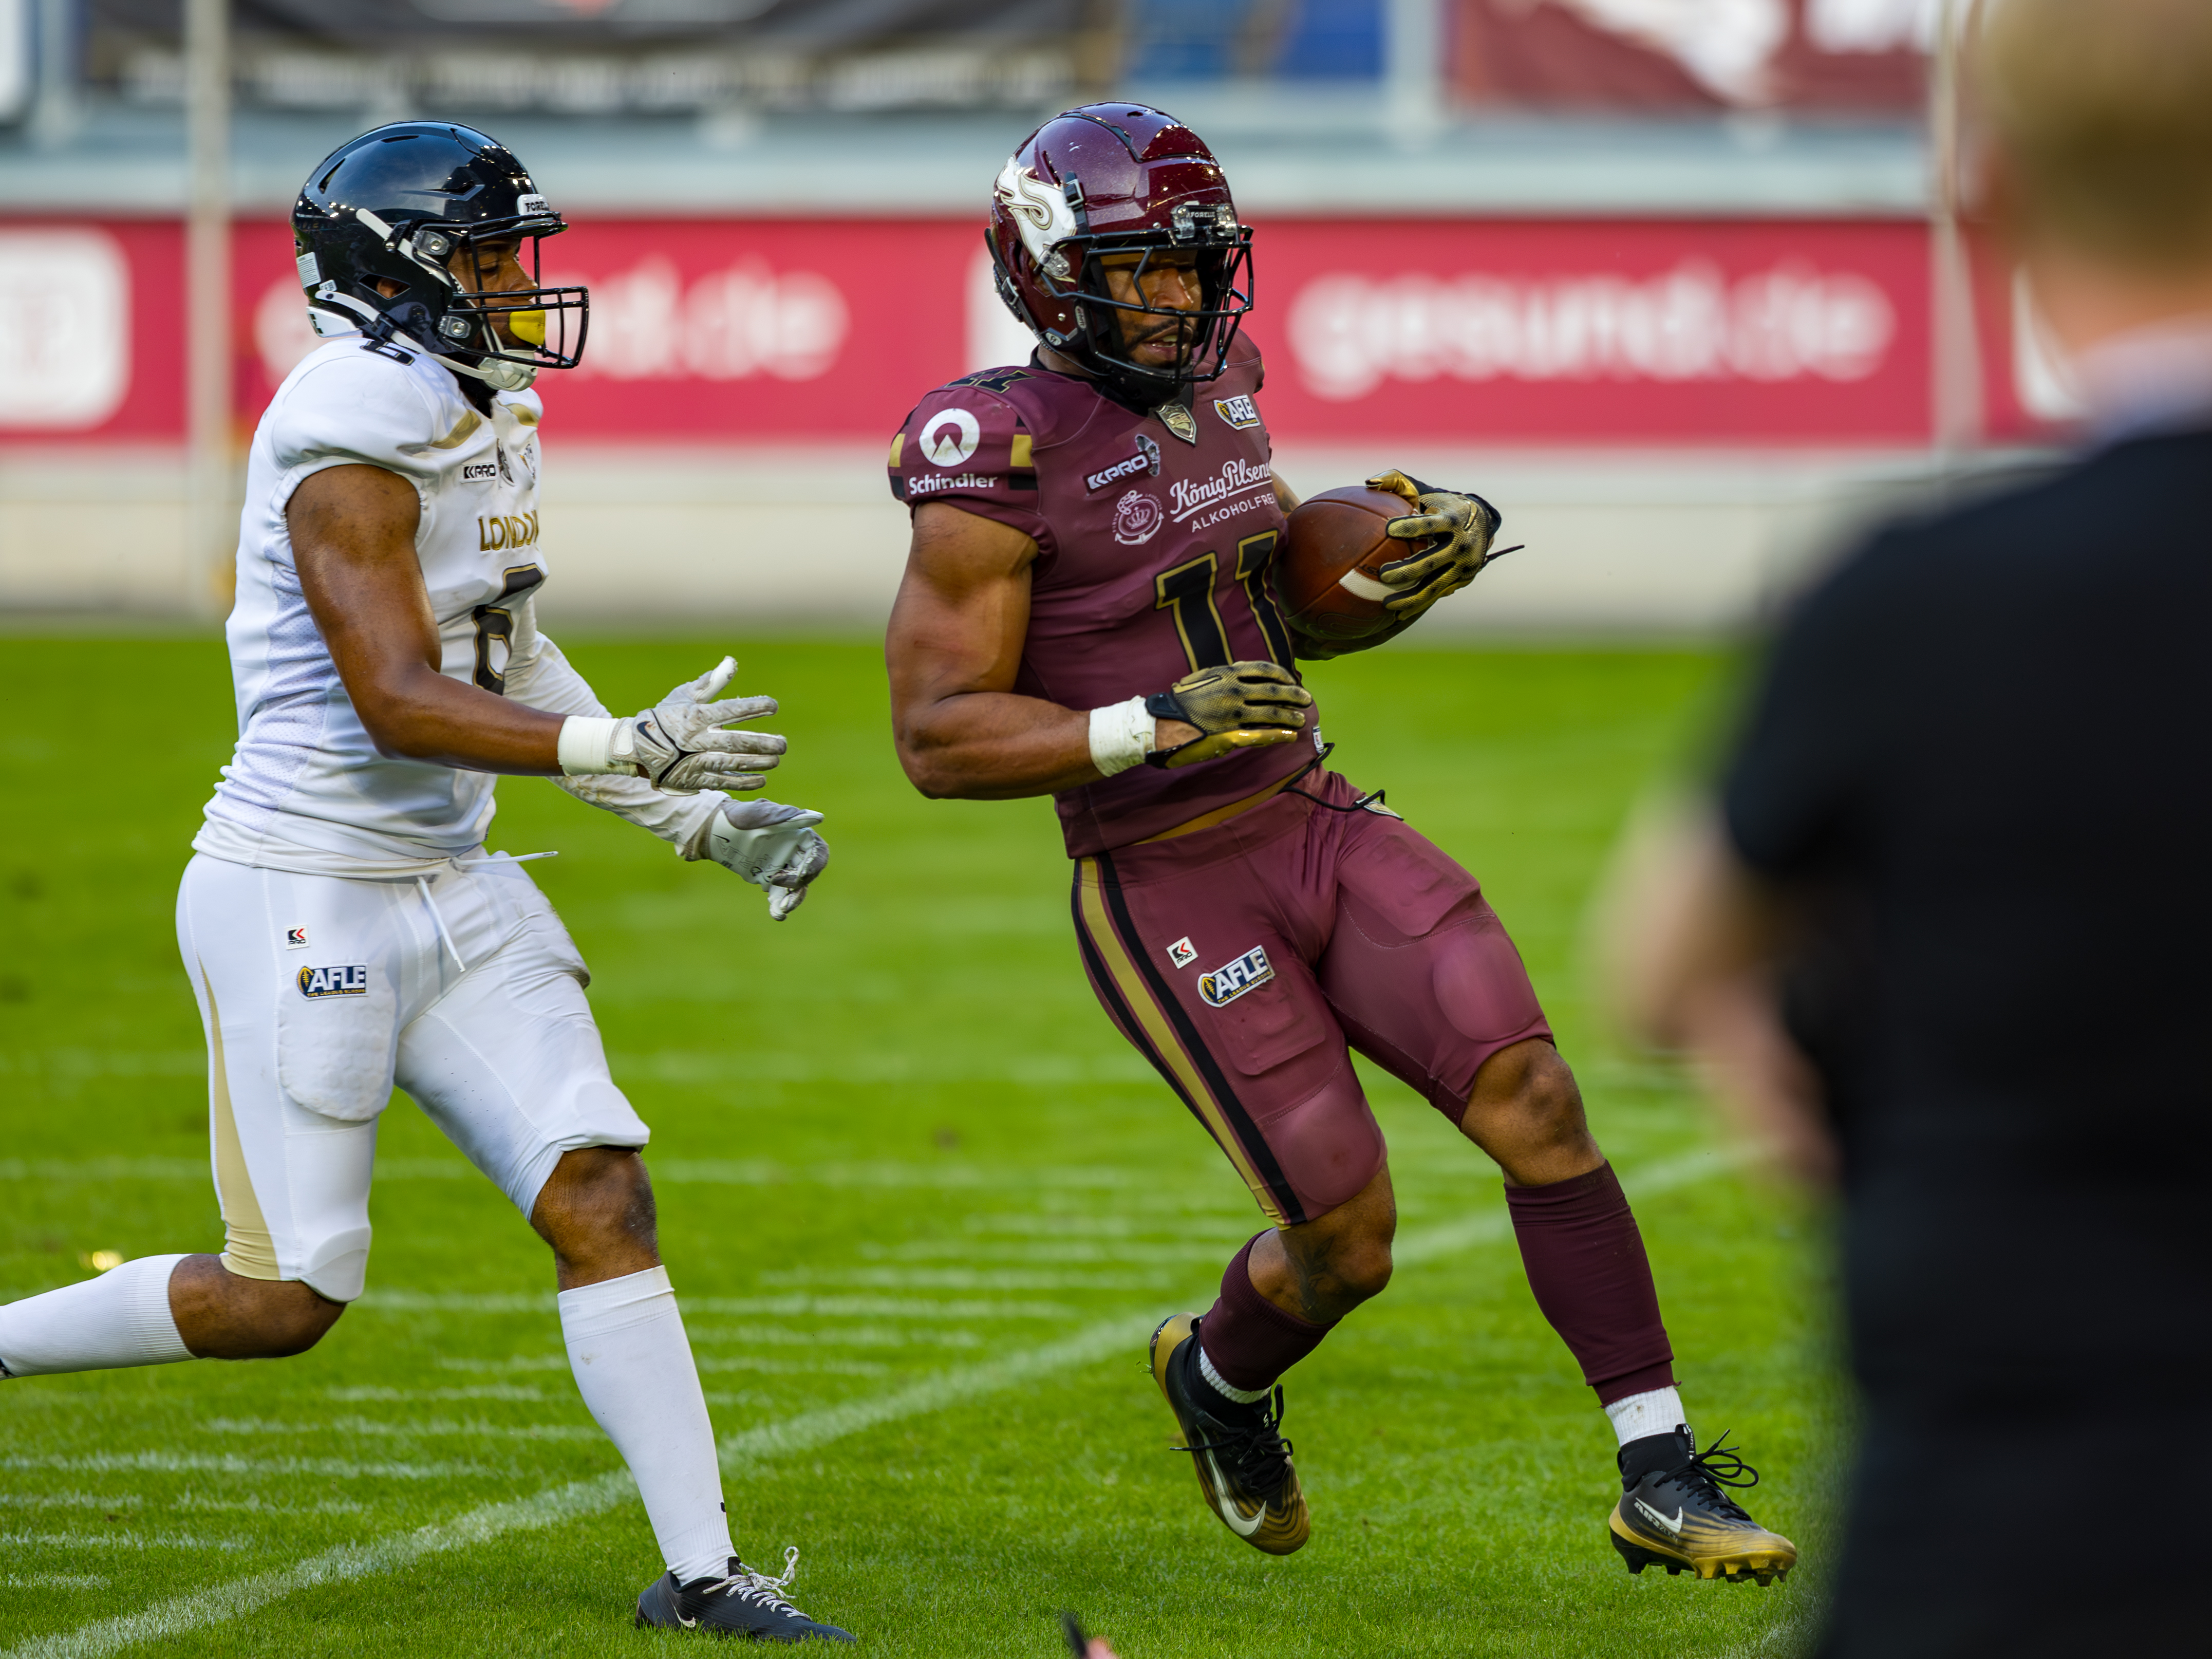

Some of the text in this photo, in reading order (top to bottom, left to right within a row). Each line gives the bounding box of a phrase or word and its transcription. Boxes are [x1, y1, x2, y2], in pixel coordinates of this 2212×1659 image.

[1292, 266, 1895, 402] gesund.de
[1226, 399, 1257, 422] AFLE
[909, 473, 998, 495] Schindler
[1154, 528, 1300, 681] 11
[307, 966, 365, 992] AFLE
[1215, 949, 1269, 1000] AFLE
[1634, 1502, 1660, 1529] AIR
